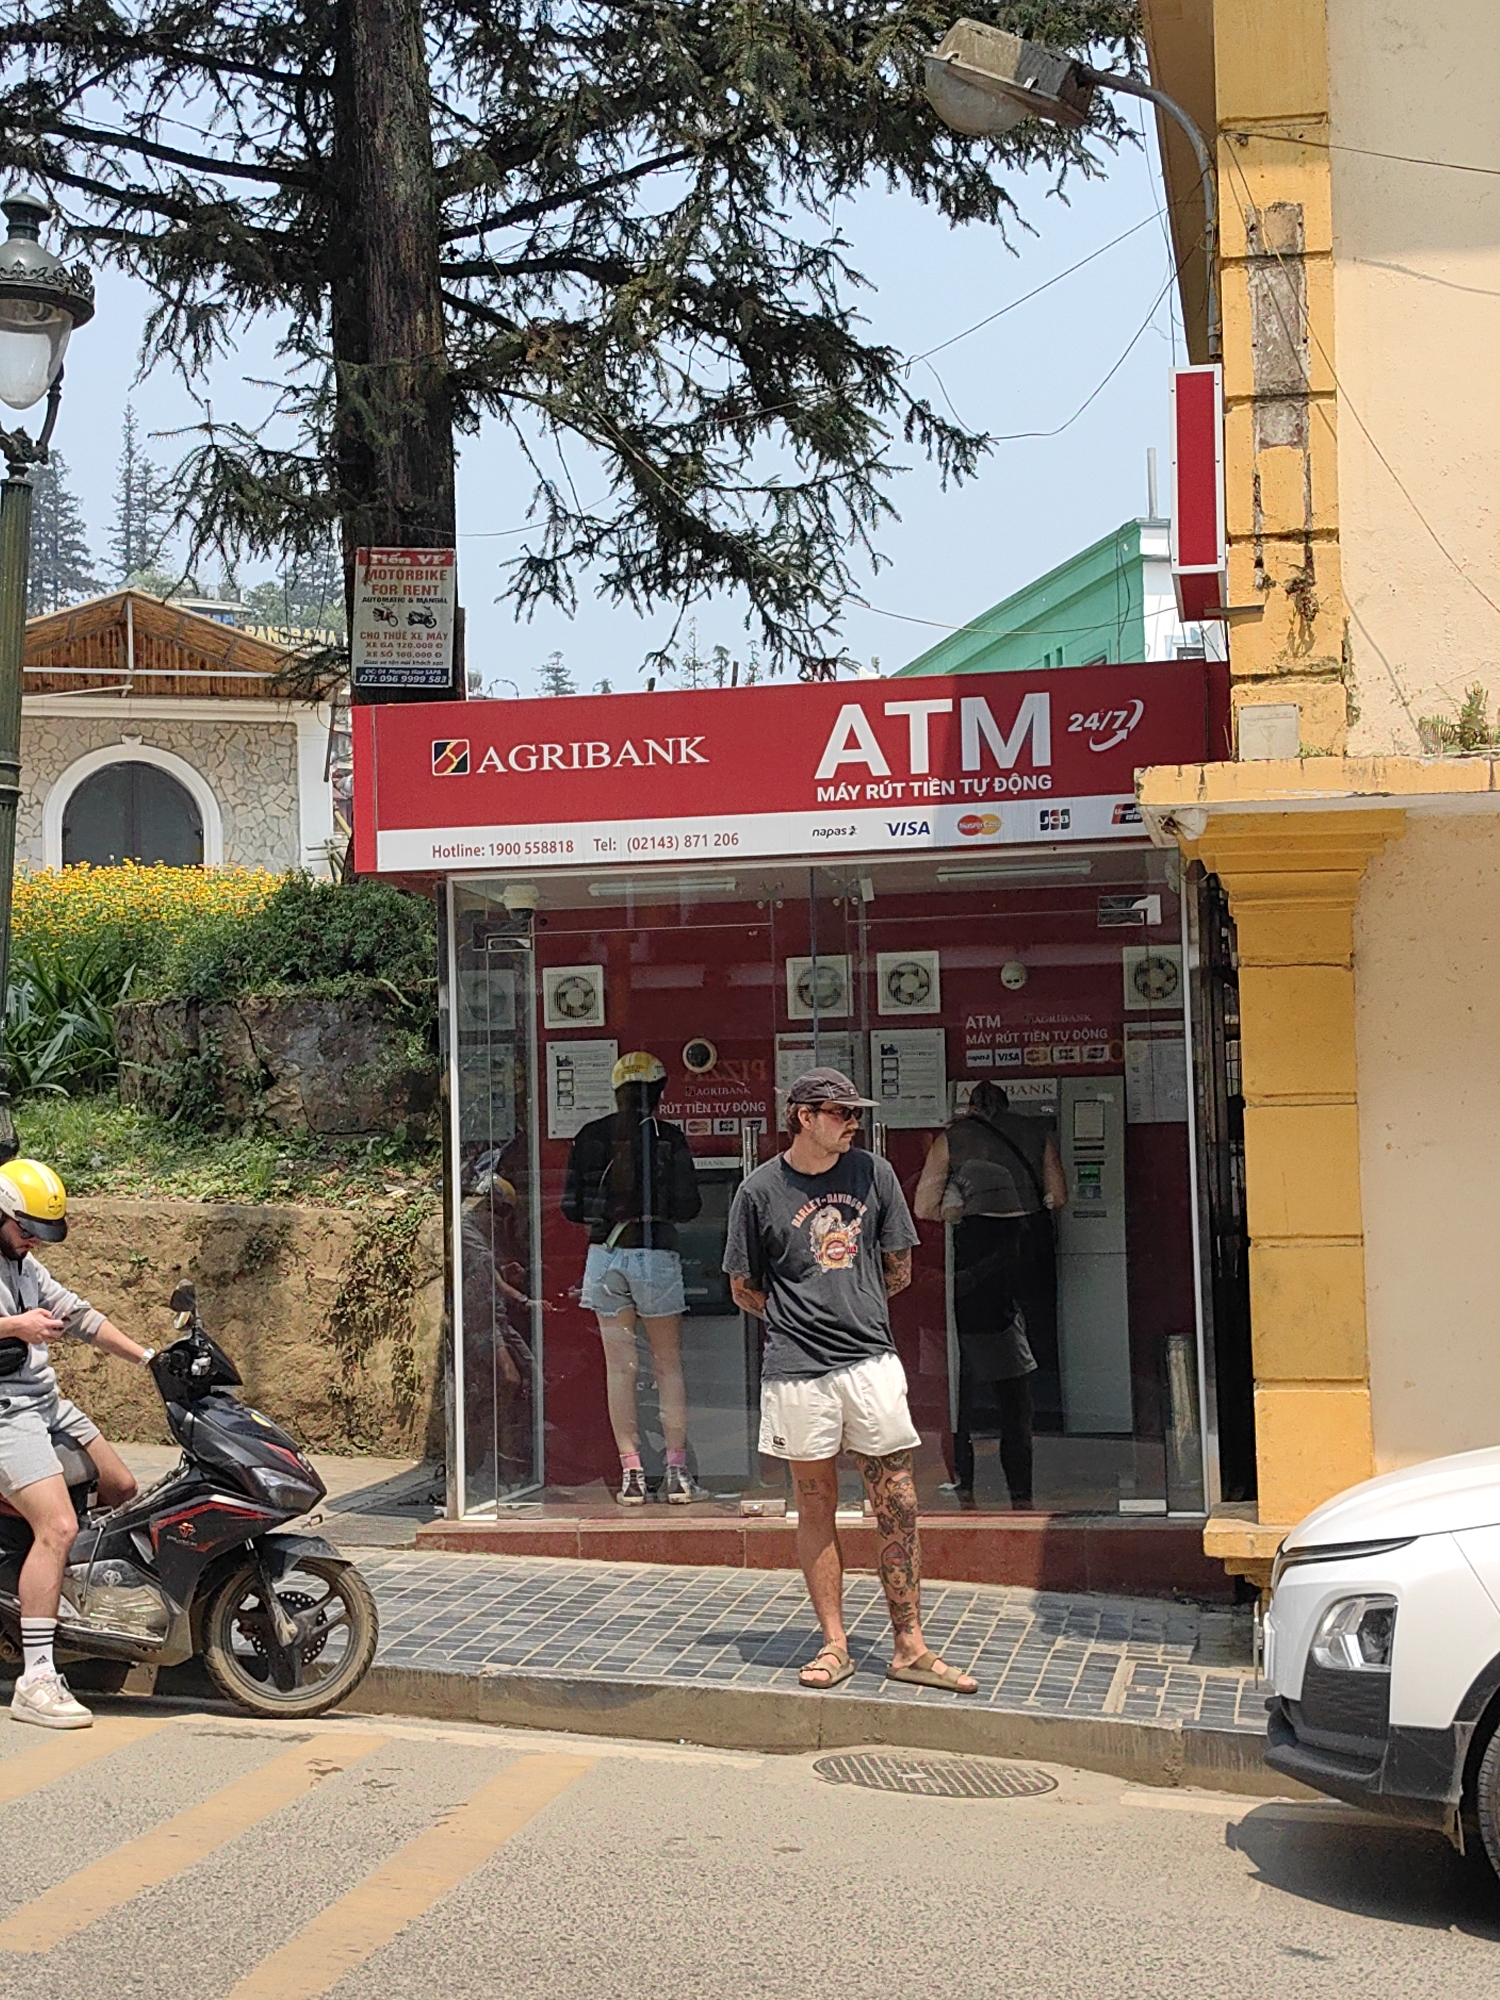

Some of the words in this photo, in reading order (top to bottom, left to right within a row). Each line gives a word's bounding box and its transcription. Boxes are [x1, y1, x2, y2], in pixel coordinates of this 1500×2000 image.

[417, 554, 445, 564] VP
[368, 569, 447, 580] MOTORBIKE
[372, 584, 398, 595] FOR
[403, 584, 439, 596] RENT
[245, 625, 337, 647] PANORAMA
[360, 632, 380, 640] CHO
[383, 631, 407, 640] THUÊ
[410, 632, 423, 640] XE
[426, 631, 448, 640] MÁY
[1068, 710, 1128, 732] 24/7
[814, 692, 1051, 779] ATM
[476, 736, 710, 774] AGRIBANK
[816, 781, 861, 802] MÁY
[866, 778, 906, 799] RÚT
[908, 776, 955, 797] TIỀN
[960, 777, 992, 797] TỰ
[993, 773, 1051, 794] ĐỘNG
[812, 826, 848, 838] napas
[884, 821, 931, 836] VISA
[432, 844, 485, 858] Hotline:
[488, 842, 521, 856] 1900
[524, 840, 574, 855] 558818
[594, 837, 616, 852] Tel:
[627, 835, 679, 853] (02143)
[684, 833, 708, 848] 871
[714, 832, 739, 846] 206
[966, 1015, 1000, 1029] ATM
[966, 1032, 996, 1045] MÁY
[996, 1030, 1020, 1044] RÚT
[1022, 1028, 1050, 1042] TIỀN
[1053, 1030, 1071, 1043] TỰ
[1073, 1027, 1108, 1041] ĐỘNG
[998, 1052, 1020, 1060] VISA
[696, 1086, 751, 1096] AGRIBANK
[960, 1083, 1053, 1098] ABANK
[659, 1102, 682, 1114] RÚT
[685, 1098, 711, 1113] TIỀN
[713, 1101, 732, 1115] TỰ
[733, 1100, 766, 1114] ĐỘNG
